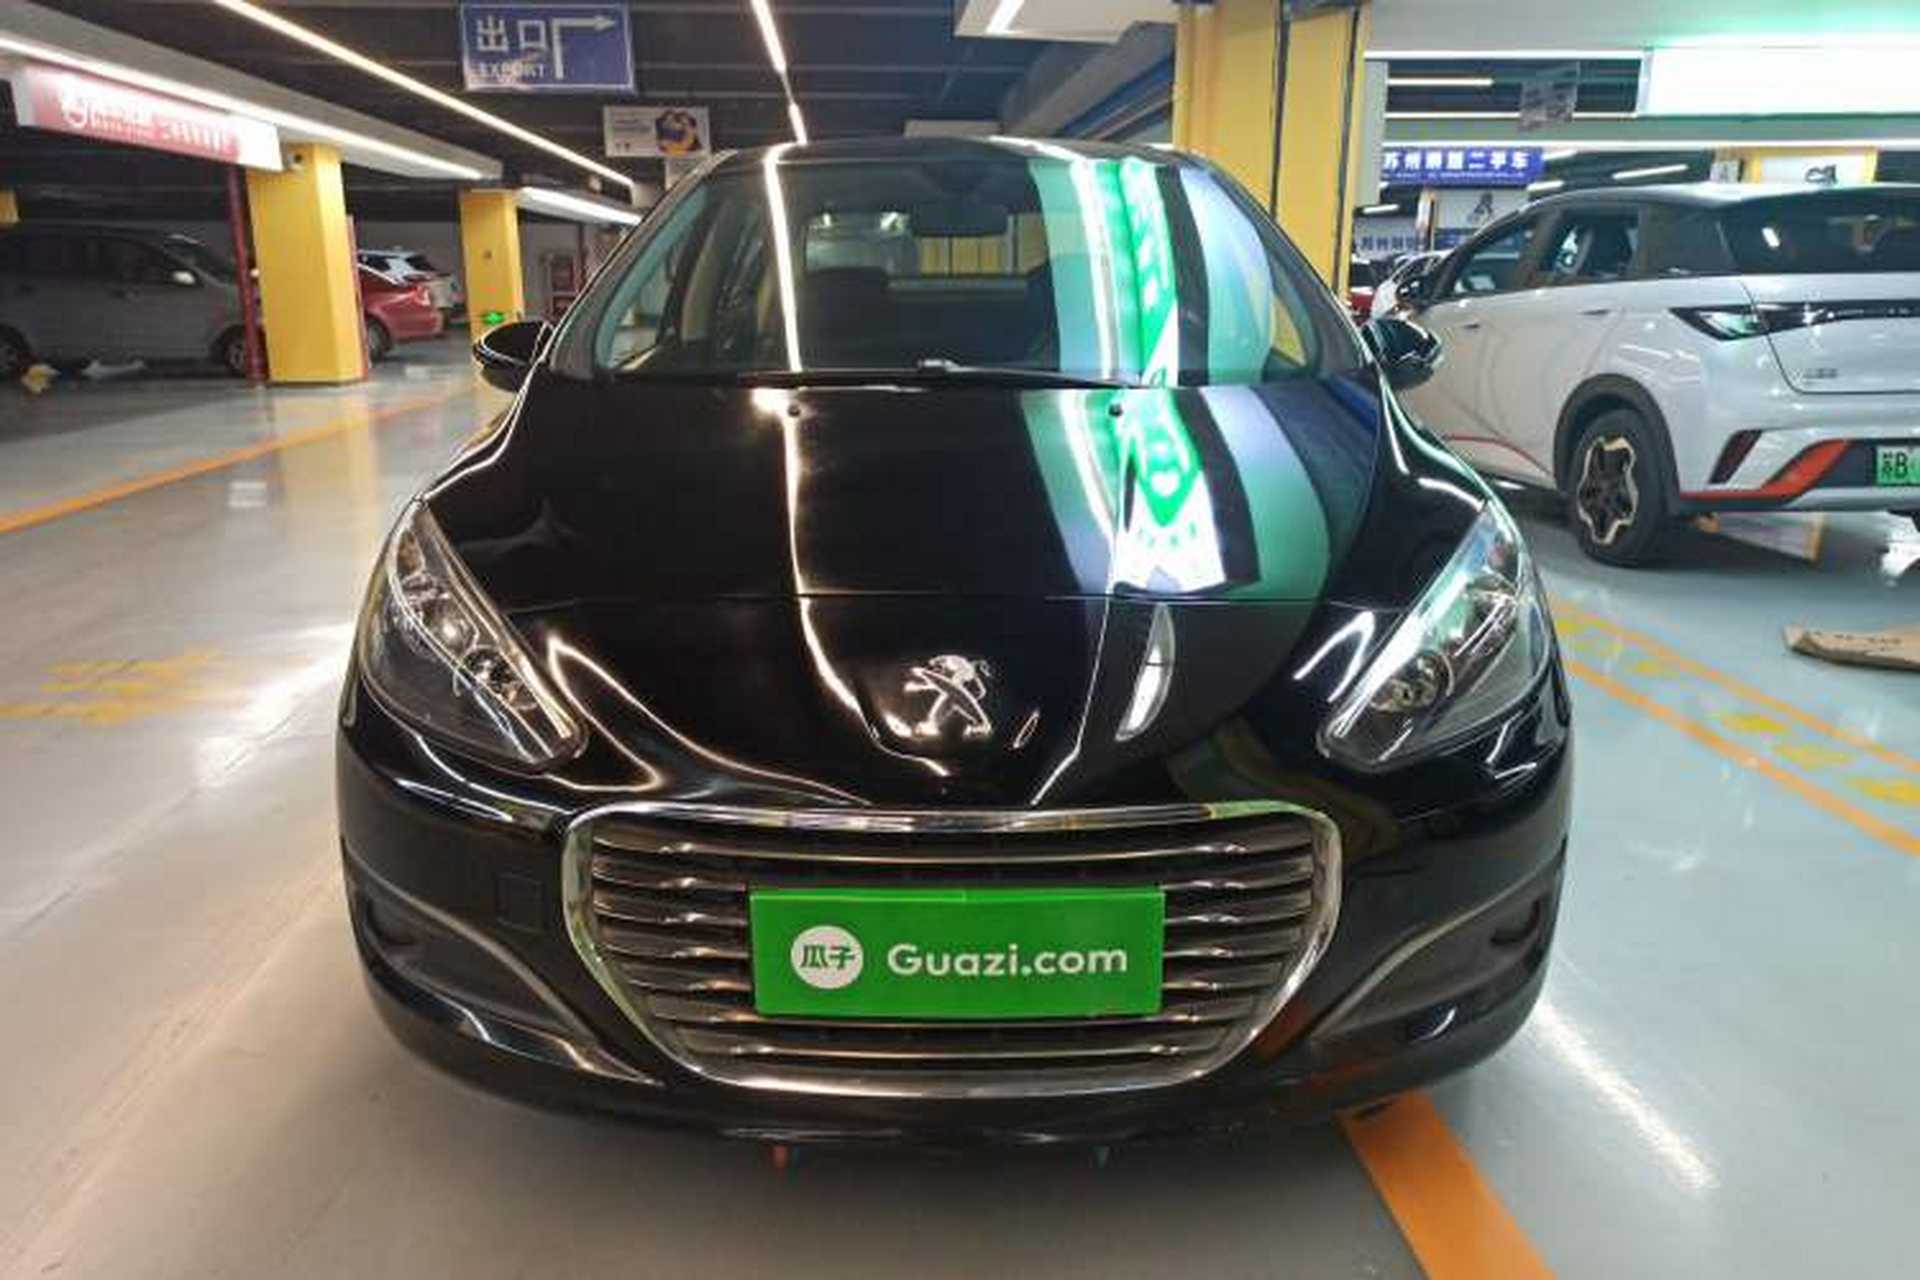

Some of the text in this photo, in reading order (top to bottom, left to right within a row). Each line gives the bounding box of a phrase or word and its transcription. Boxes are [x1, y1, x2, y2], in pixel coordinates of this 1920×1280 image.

[476, 15, 547, 51] 出口
[800, 944, 1128, 976] 瓜子 Guazi.com
